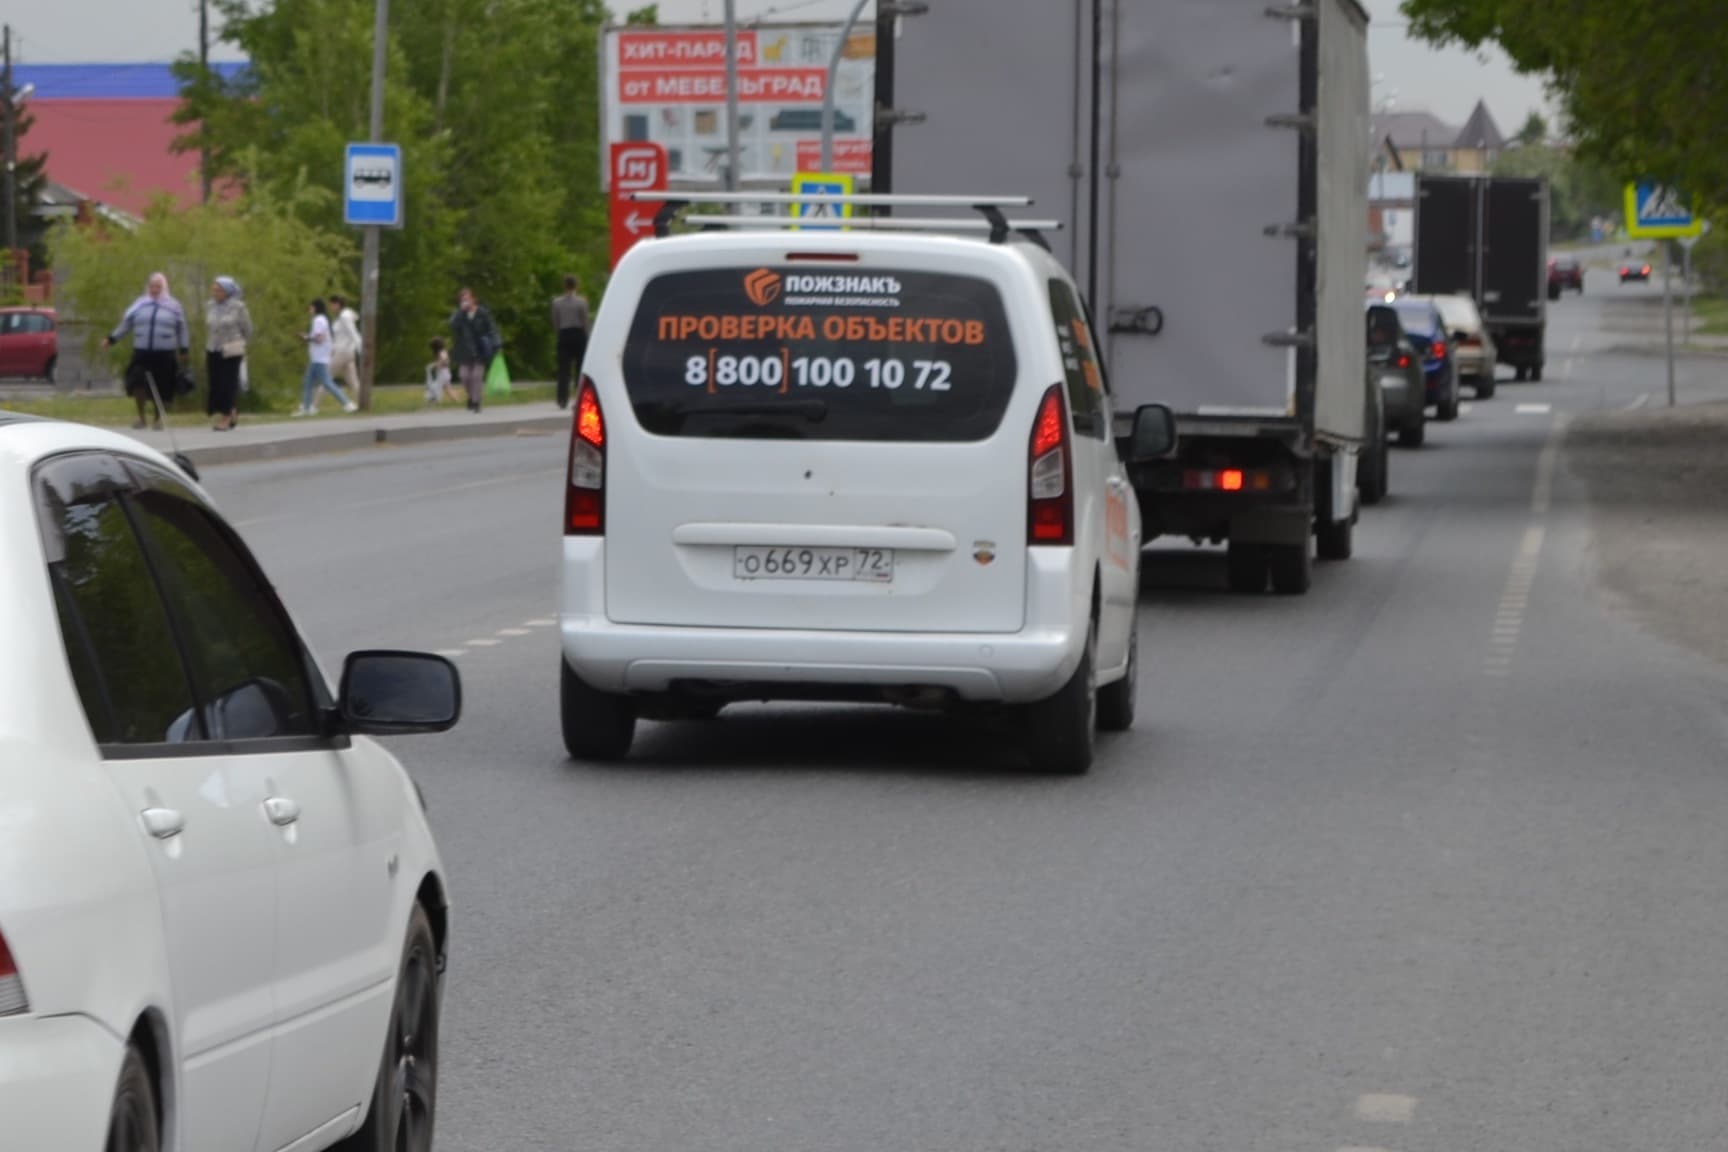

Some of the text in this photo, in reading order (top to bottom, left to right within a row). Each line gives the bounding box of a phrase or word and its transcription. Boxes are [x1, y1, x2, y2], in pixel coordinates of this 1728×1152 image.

[625, 80, 649, 96] от
[786, 275, 902, 294] ПОЖЗНАКЪ
[659, 316, 985, 345] ПРОВЕРКА ОБЪЕКТОВ
[864, 359, 904, 389] 10
[913, 360, 952, 391] 72
